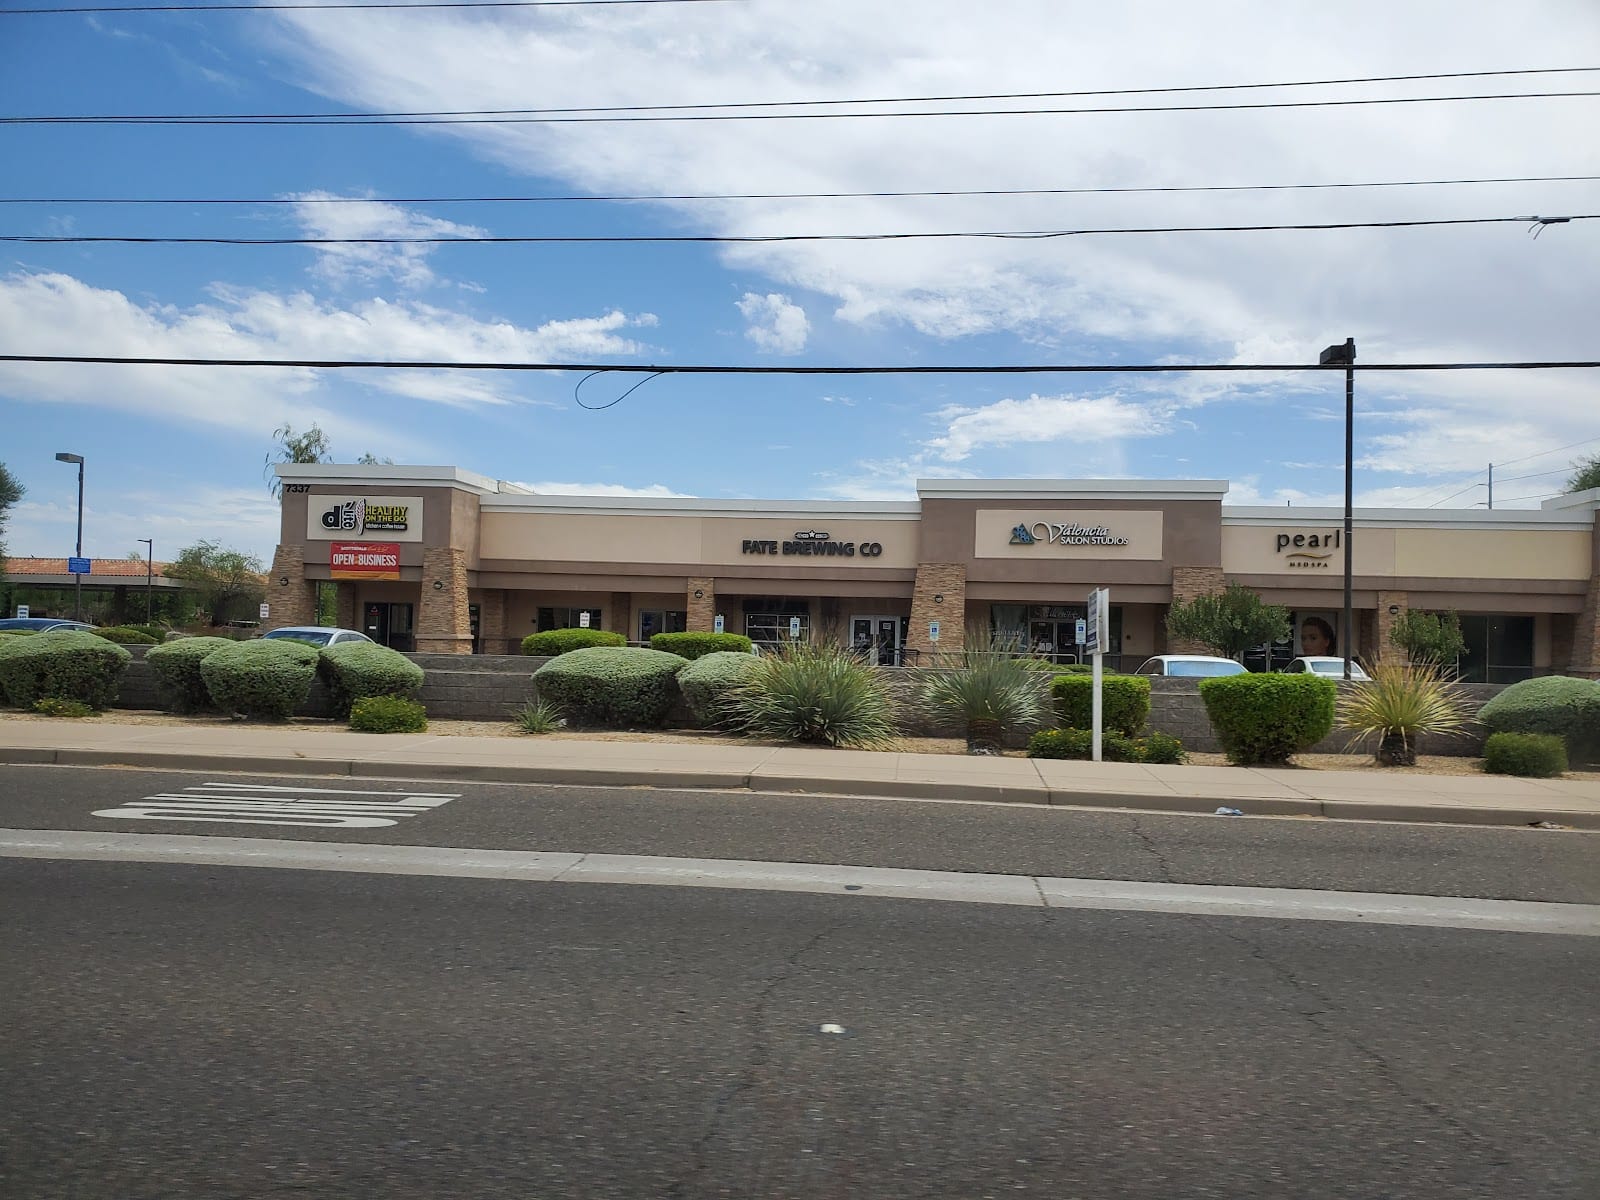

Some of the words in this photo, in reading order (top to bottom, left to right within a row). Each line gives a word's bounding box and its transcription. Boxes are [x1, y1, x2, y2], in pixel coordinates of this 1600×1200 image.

[285, 484, 310, 493] 7337
[365, 505, 407, 516] HEALTHY
[1031, 521, 1109, 544] Valencia
[1060, 536, 1089, 545] SALON
[1091, 536, 1129, 545] STUDIOS
[1277, 529, 1340, 552] pearl
[742, 540, 778, 555] FATE
[782, 541, 855, 556] BREWING
[859, 542, 883, 557] CO
[333, 553, 355, 565] OPEN
[358, 554, 397, 566] BUSINESS
